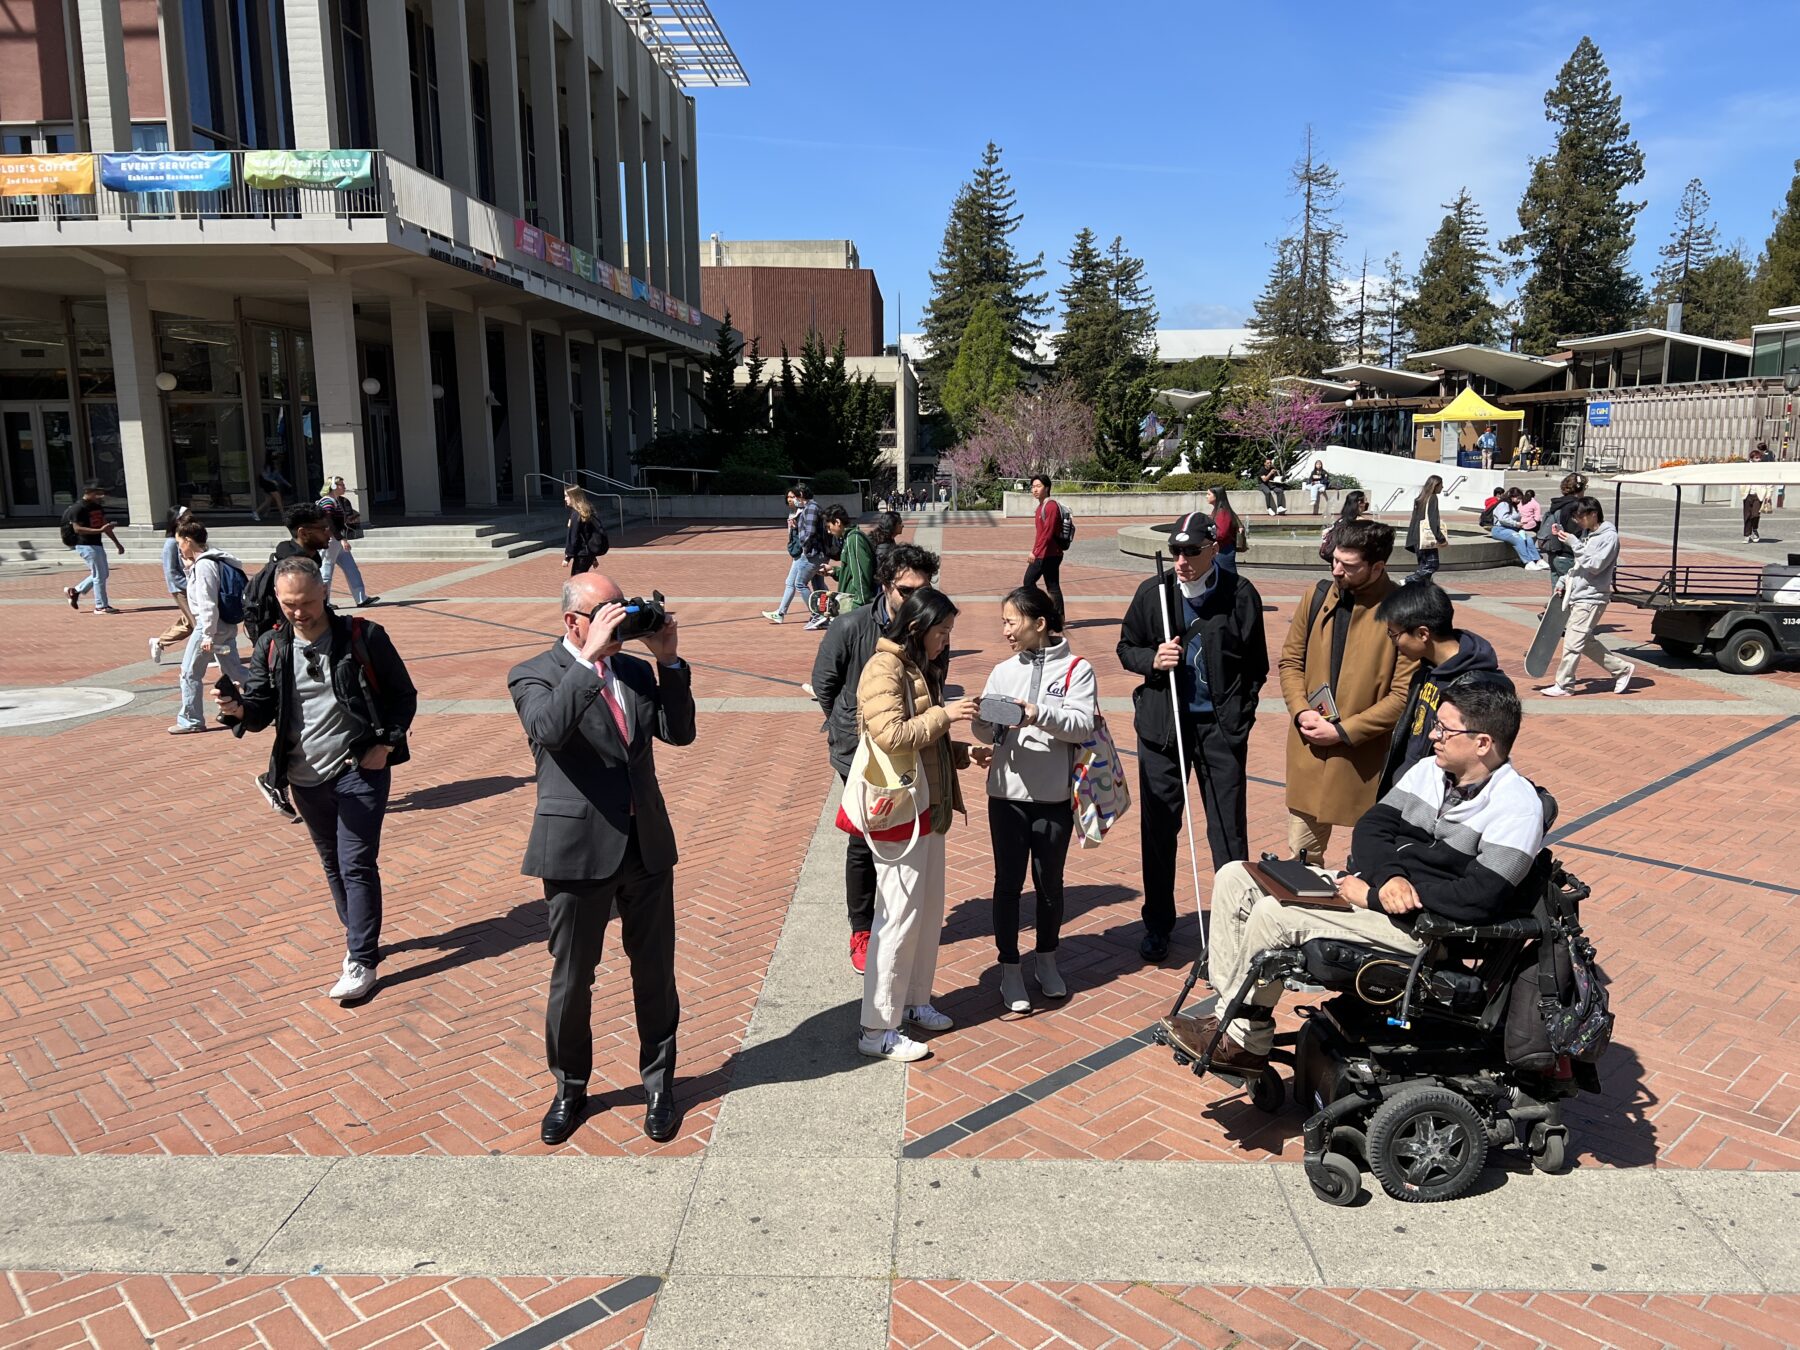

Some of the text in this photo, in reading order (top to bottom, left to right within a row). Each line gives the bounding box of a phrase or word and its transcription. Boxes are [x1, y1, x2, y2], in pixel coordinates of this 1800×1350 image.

[0, 162, 78, 173] LDIE'S COFFEE
[120, 161, 211, 170] EVENT SERVICES
[332, 158, 360, 168] WEST
